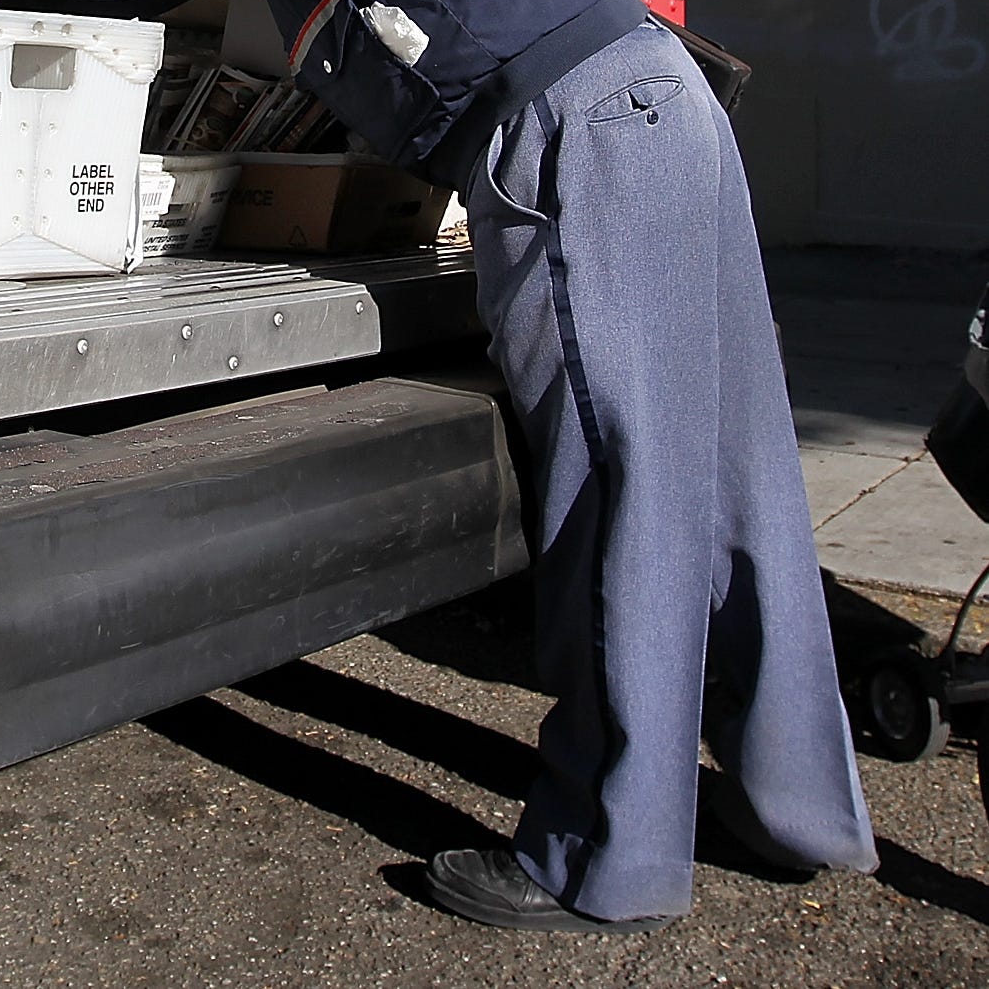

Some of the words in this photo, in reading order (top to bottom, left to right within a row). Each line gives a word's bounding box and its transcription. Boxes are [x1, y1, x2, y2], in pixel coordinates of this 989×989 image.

[72, 165, 114, 179] LABEL
[69, 181, 114, 196] OTHER
[77, 198, 104, 213] END
